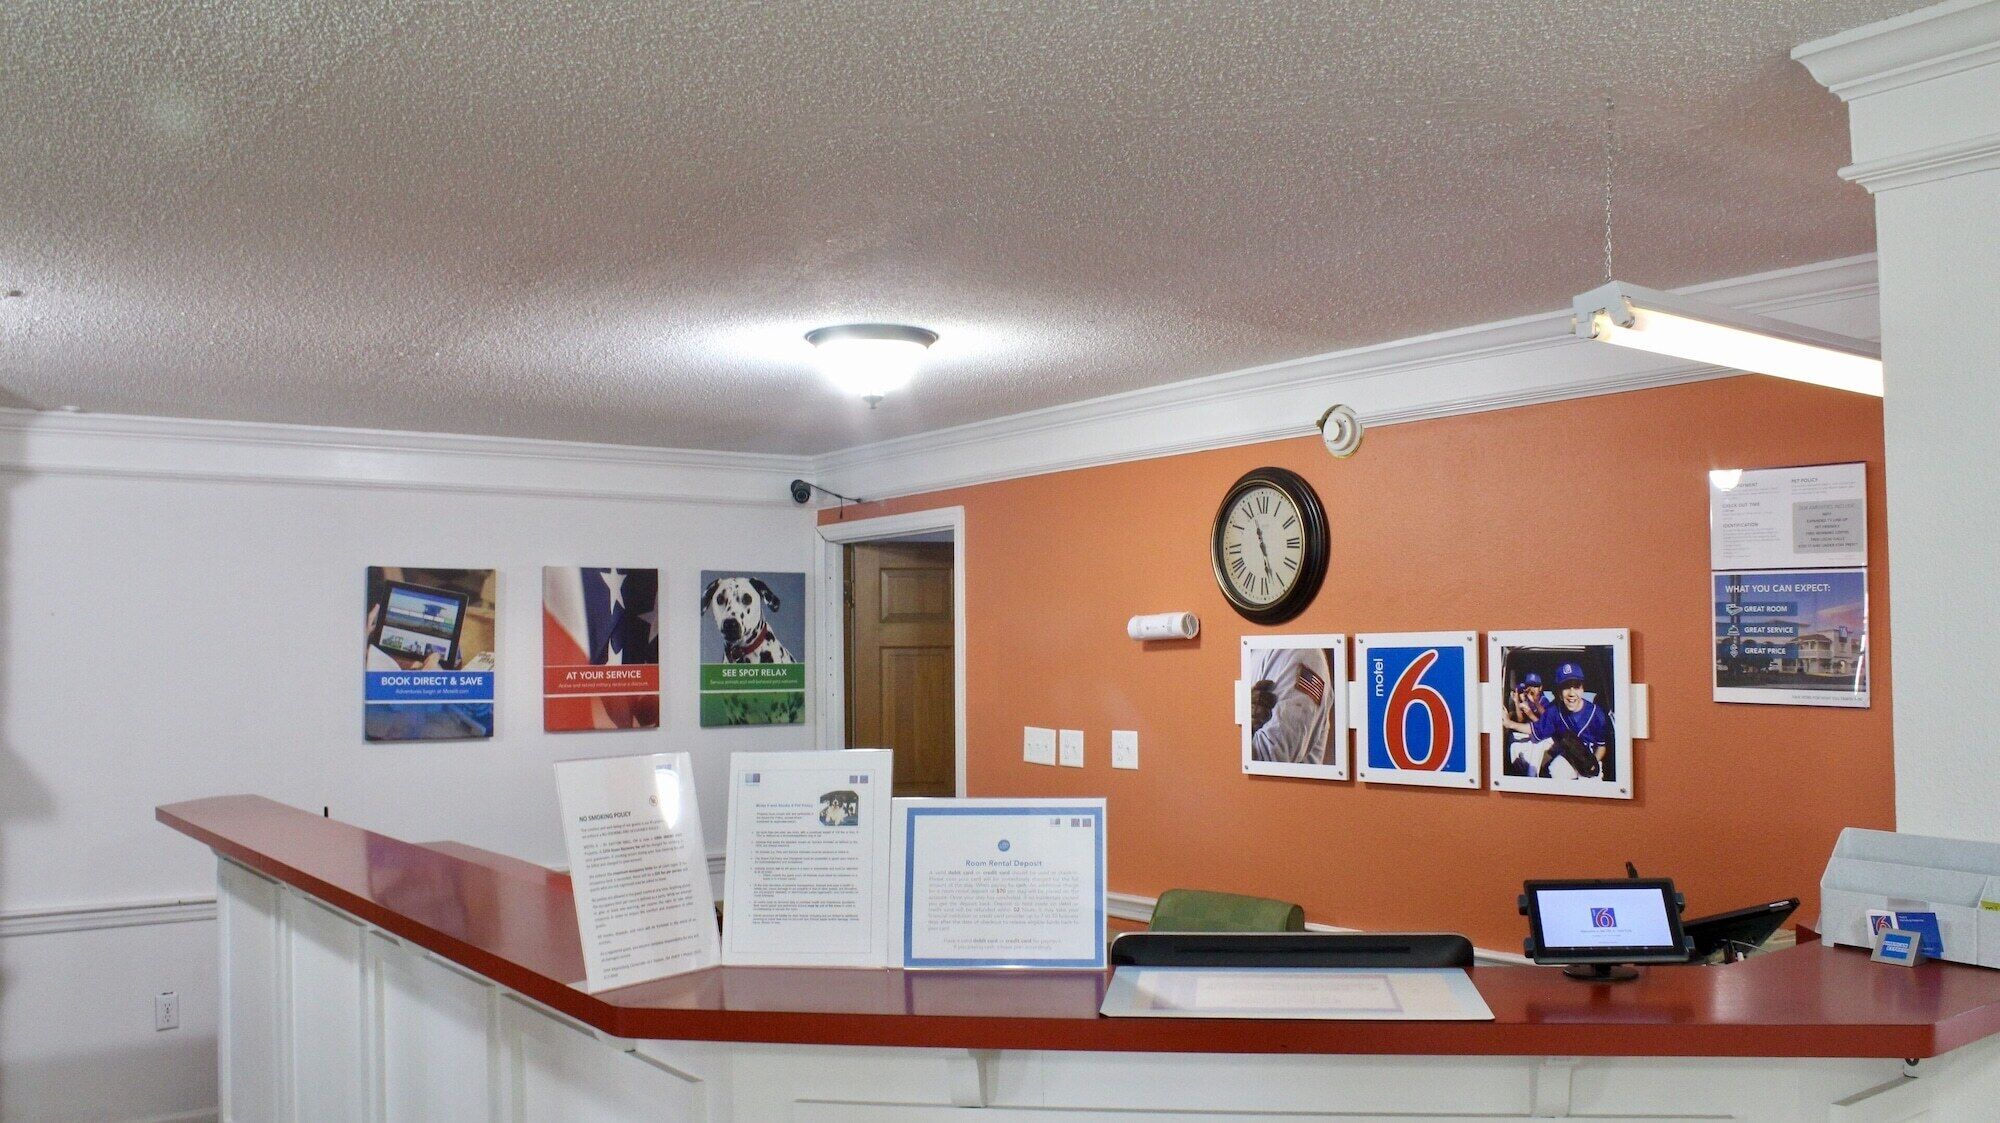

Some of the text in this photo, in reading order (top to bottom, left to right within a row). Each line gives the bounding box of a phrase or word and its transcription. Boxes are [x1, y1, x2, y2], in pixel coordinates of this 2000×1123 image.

[1725, 585, 1749, 593] WHAT
[1794, 584, 1831, 592] EXPECT:
[1744, 605, 1765, 613] GREAT
[1744, 626, 1793, 634] GREAT SERVICE
[1744, 647, 1786, 655] GREAT PRICE
[566, 670, 642, 680] AT YOUR SERVICE
[722, 668, 787, 677] SEE SPOT RELAX
[381, 676, 483, 686] BOOK DIRECT & SAVE
[1373, 648, 1454, 772] motel 6
[588, 813, 613, 821] SMOKING
[614, 811, 631, 819] POLICY
[988, 859, 1012, 867] Rental
[1014, 860, 1042, 868] Deposit
[1595, 908, 1614, 928] 6
